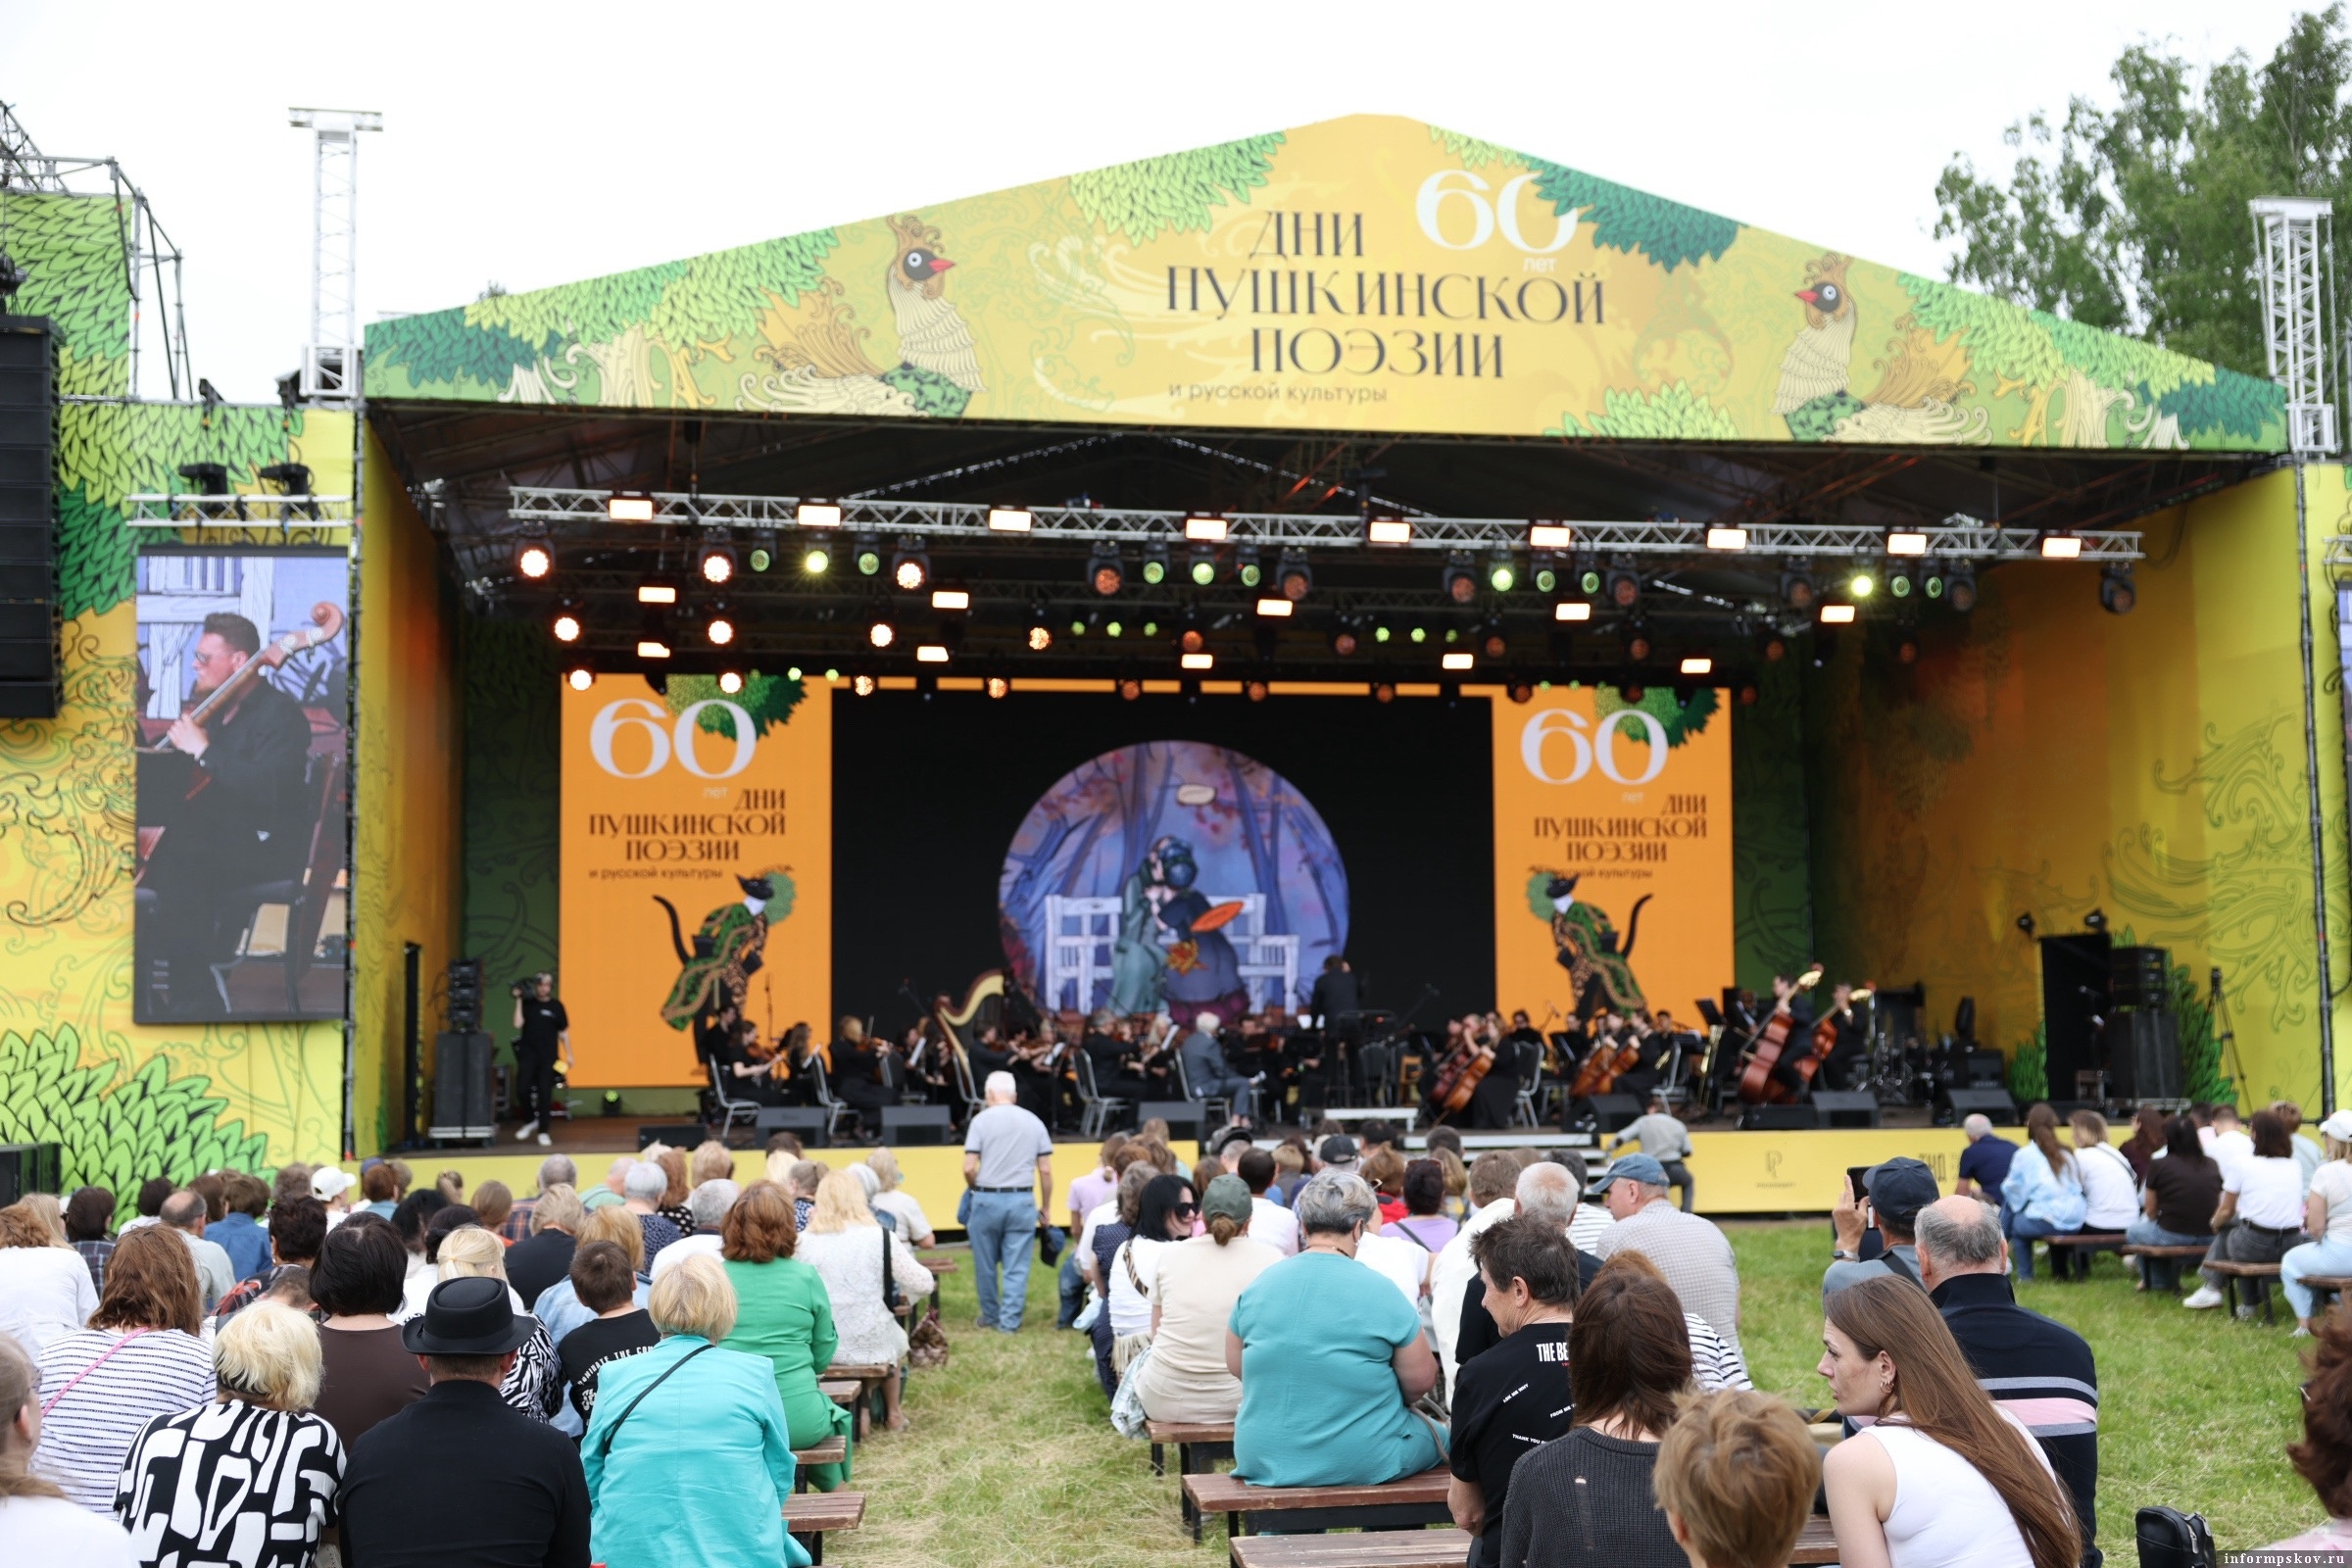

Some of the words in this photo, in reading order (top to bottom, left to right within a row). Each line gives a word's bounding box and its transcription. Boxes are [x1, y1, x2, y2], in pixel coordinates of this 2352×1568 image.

[1416, 169, 1579, 253] 60
[1249, 211, 1364, 261] ДНИ
[1522, 255, 1556, 273] лет
[1166, 266, 1605, 325] ПУШКИНСКОЙ
[1251, 327, 1503, 379] ПОЭЗИИ
[1168, 383, 1182, 398] и
[1189, 381, 1280, 403] русской
[1287, 385, 1388, 405] культуры
[589, 698, 758, 780] 60
[1520, 708, 1669, 785] 60
[734, 788, 786, 811] ДНИ
[1662, 794, 1707, 815] ДНИ
[589, 812, 786, 839] ПУШКИНСКОЙ
[1534, 815, 1707, 840] ПУШКИНСКОЙ
[625, 839, 740, 862] ПОЭЗИИ
[1566, 841, 1667, 862] ПОЭЗИИ
[600, 865, 658, 880] русской
[661, 867, 723, 880] культуры
[613, 1348, 632, 1361] THE
[1536, 1343, 1556, 1362] THE
[1549, 1408, 1564, 1419] FROM
[1512, 1433, 1529, 1442] THANK
